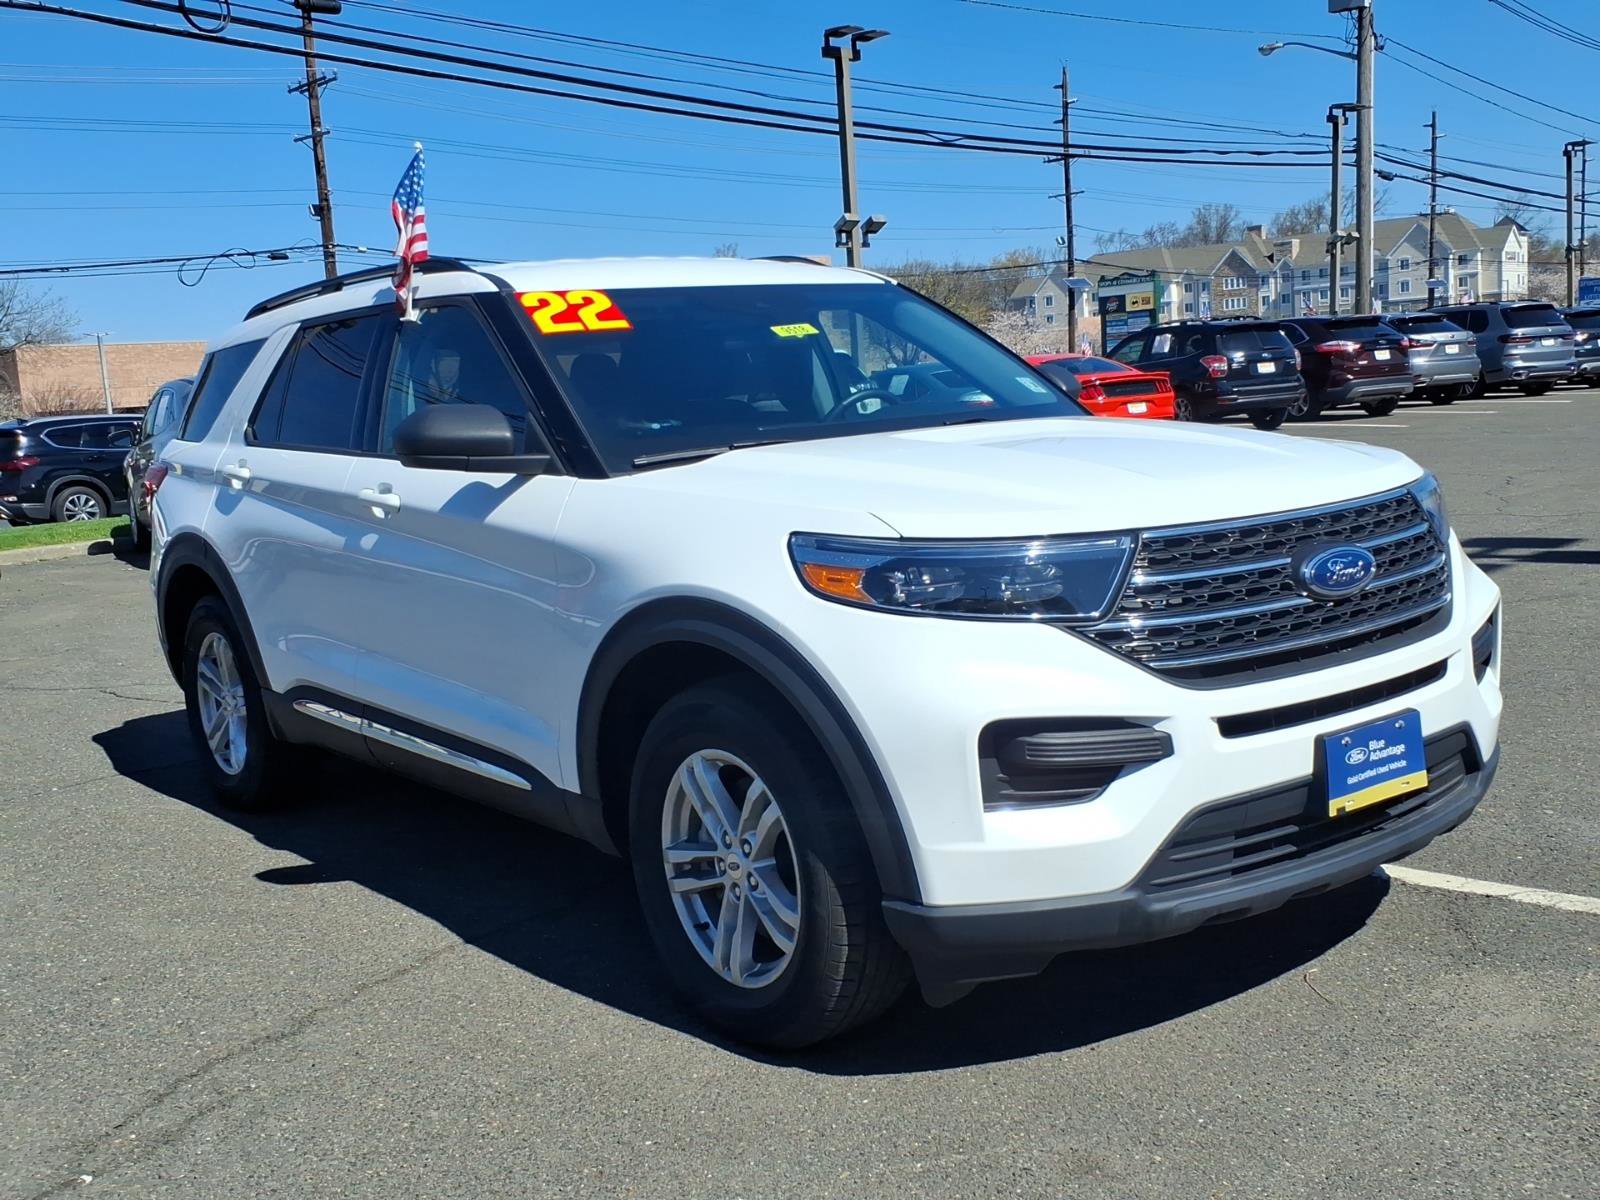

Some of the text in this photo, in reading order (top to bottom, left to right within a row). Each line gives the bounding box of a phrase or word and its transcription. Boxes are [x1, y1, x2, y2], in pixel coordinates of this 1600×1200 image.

[521, 289, 630, 334] 22
[1326, 556, 1365, 584] Ford
[1369, 740, 1385, 751] Blue
[1370, 744, 1405, 761] Advantage
